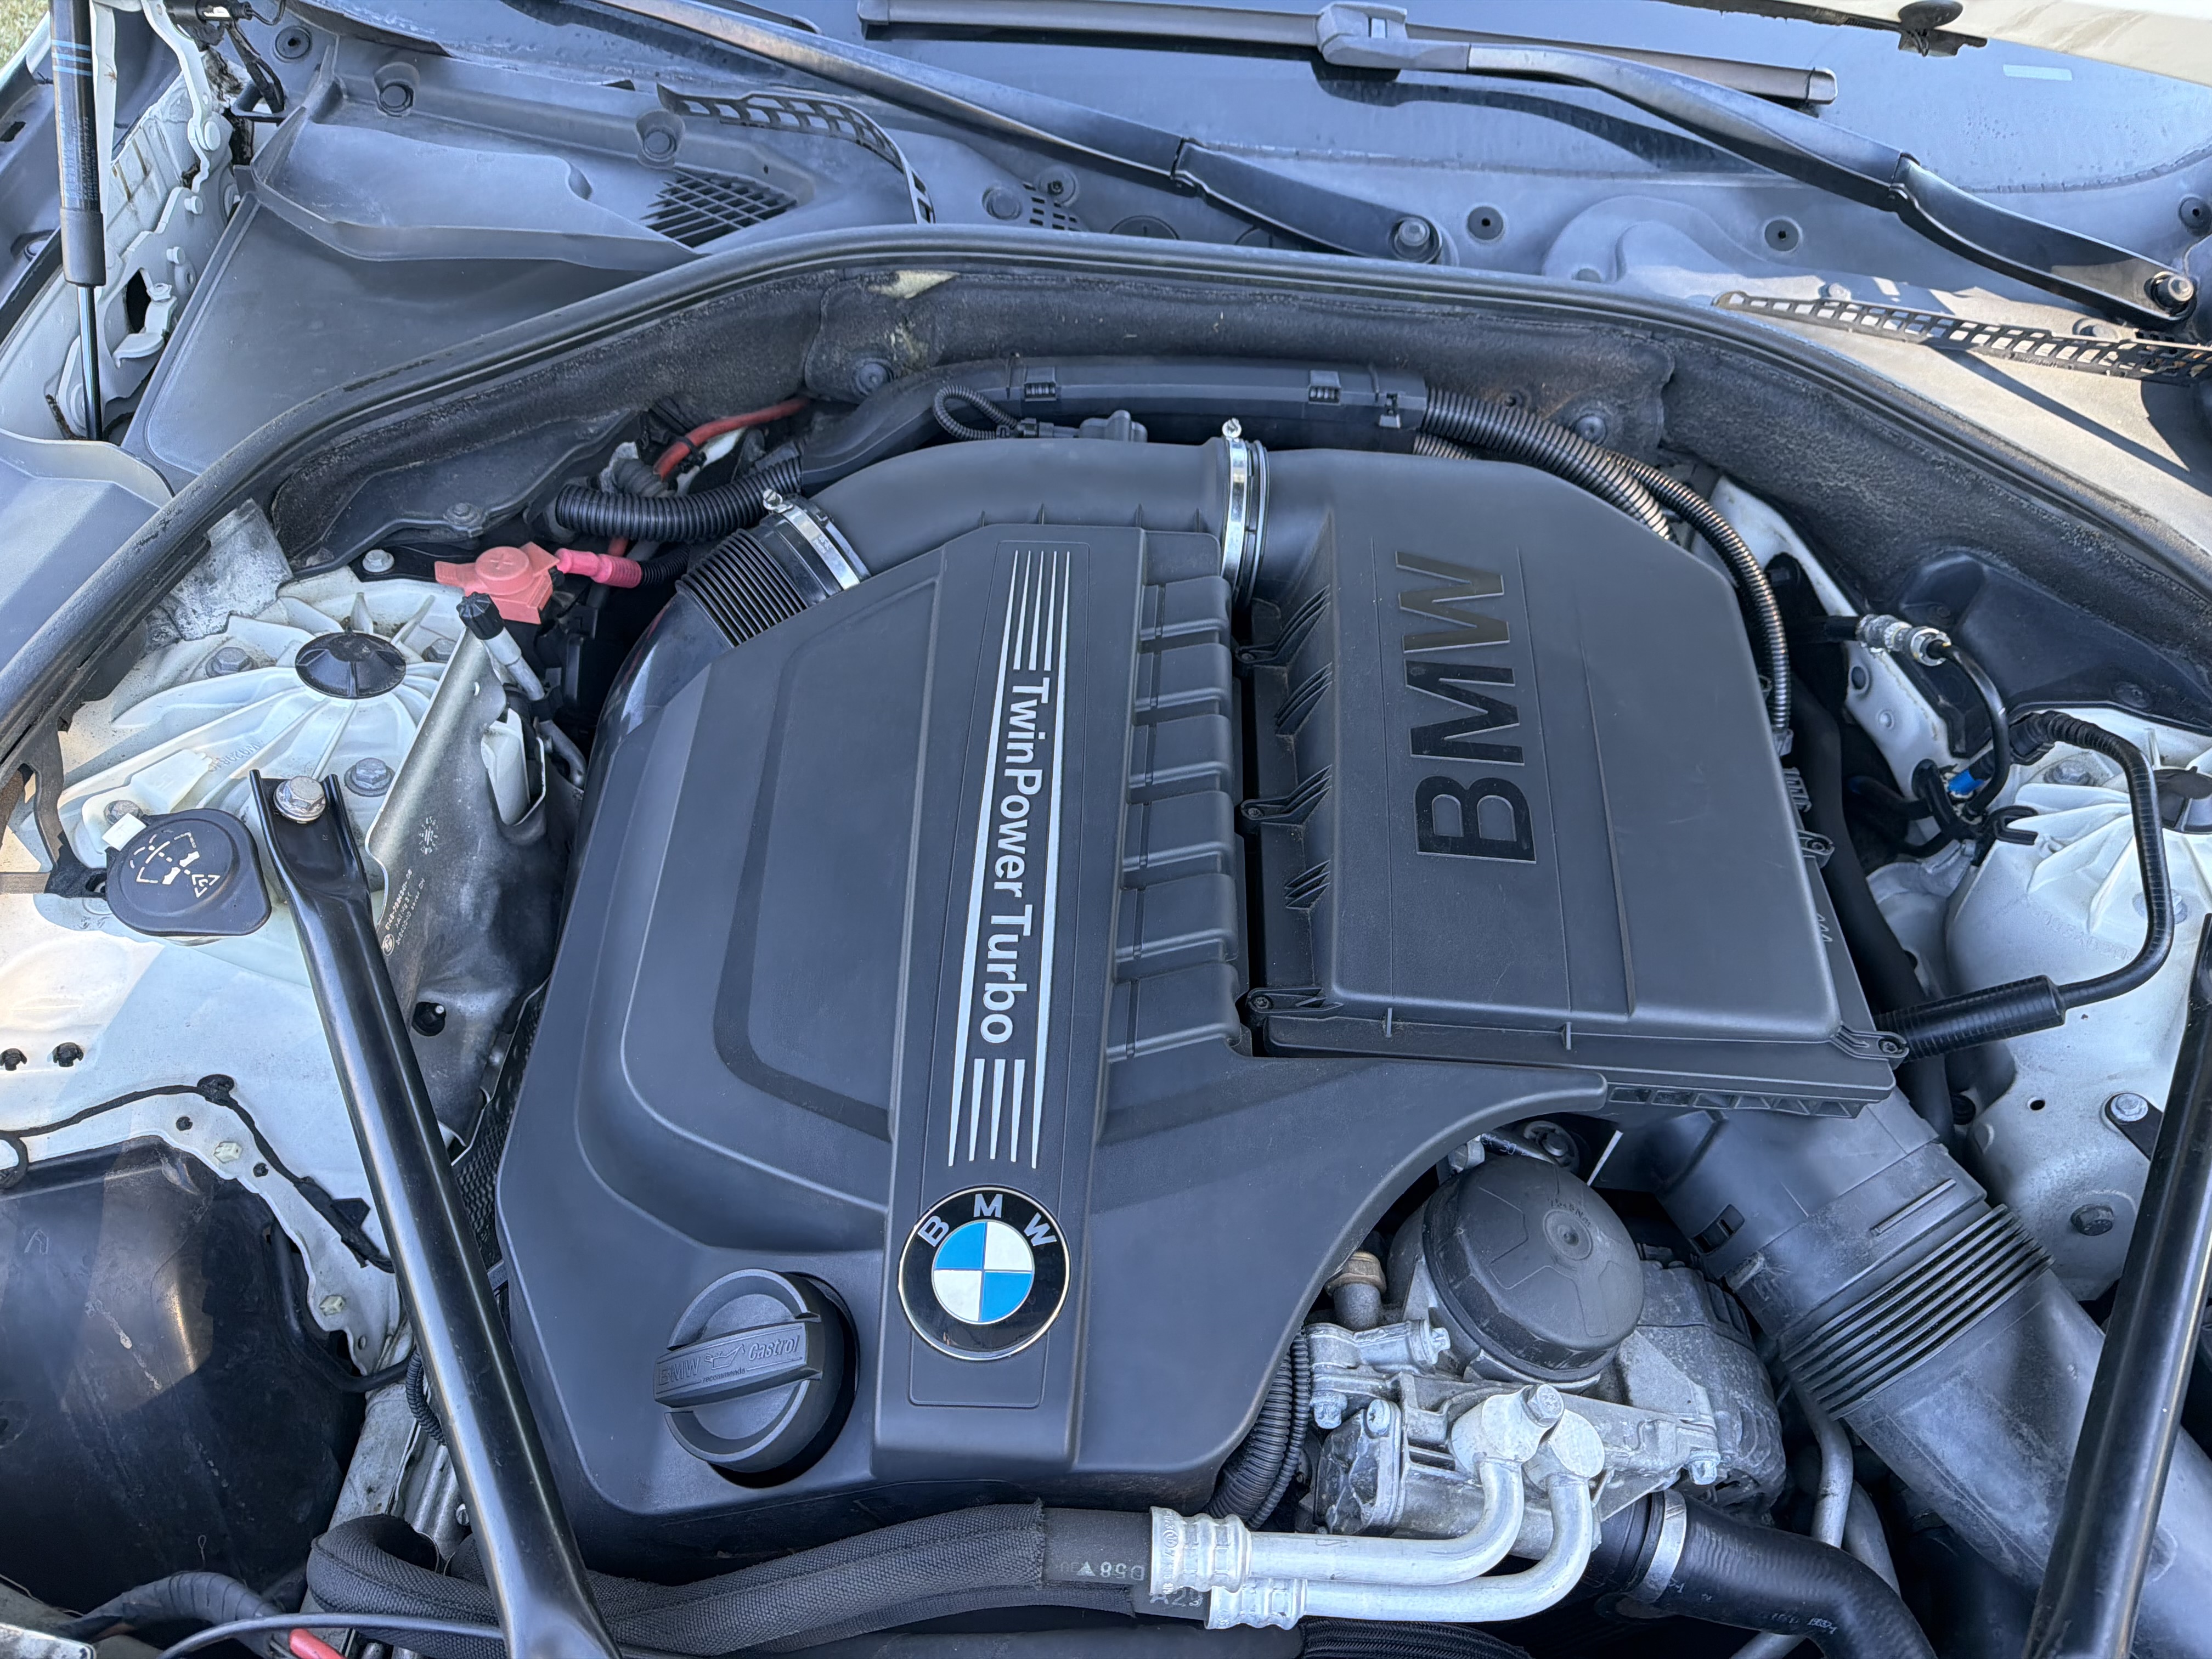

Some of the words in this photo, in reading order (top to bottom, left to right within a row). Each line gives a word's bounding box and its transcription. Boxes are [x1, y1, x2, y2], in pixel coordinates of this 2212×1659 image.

[1395, 550, 1536, 864] BMW
[995, 678, 1050, 898] TwinPower
[980, 904, 1033, 1043] Turbo
[917, 1194, 1057, 1248] BMW
[658, 1356, 701, 1386] BMW
[702, 1367, 746, 1383] recommends
[748, 1335, 800, 1361] Castrol
